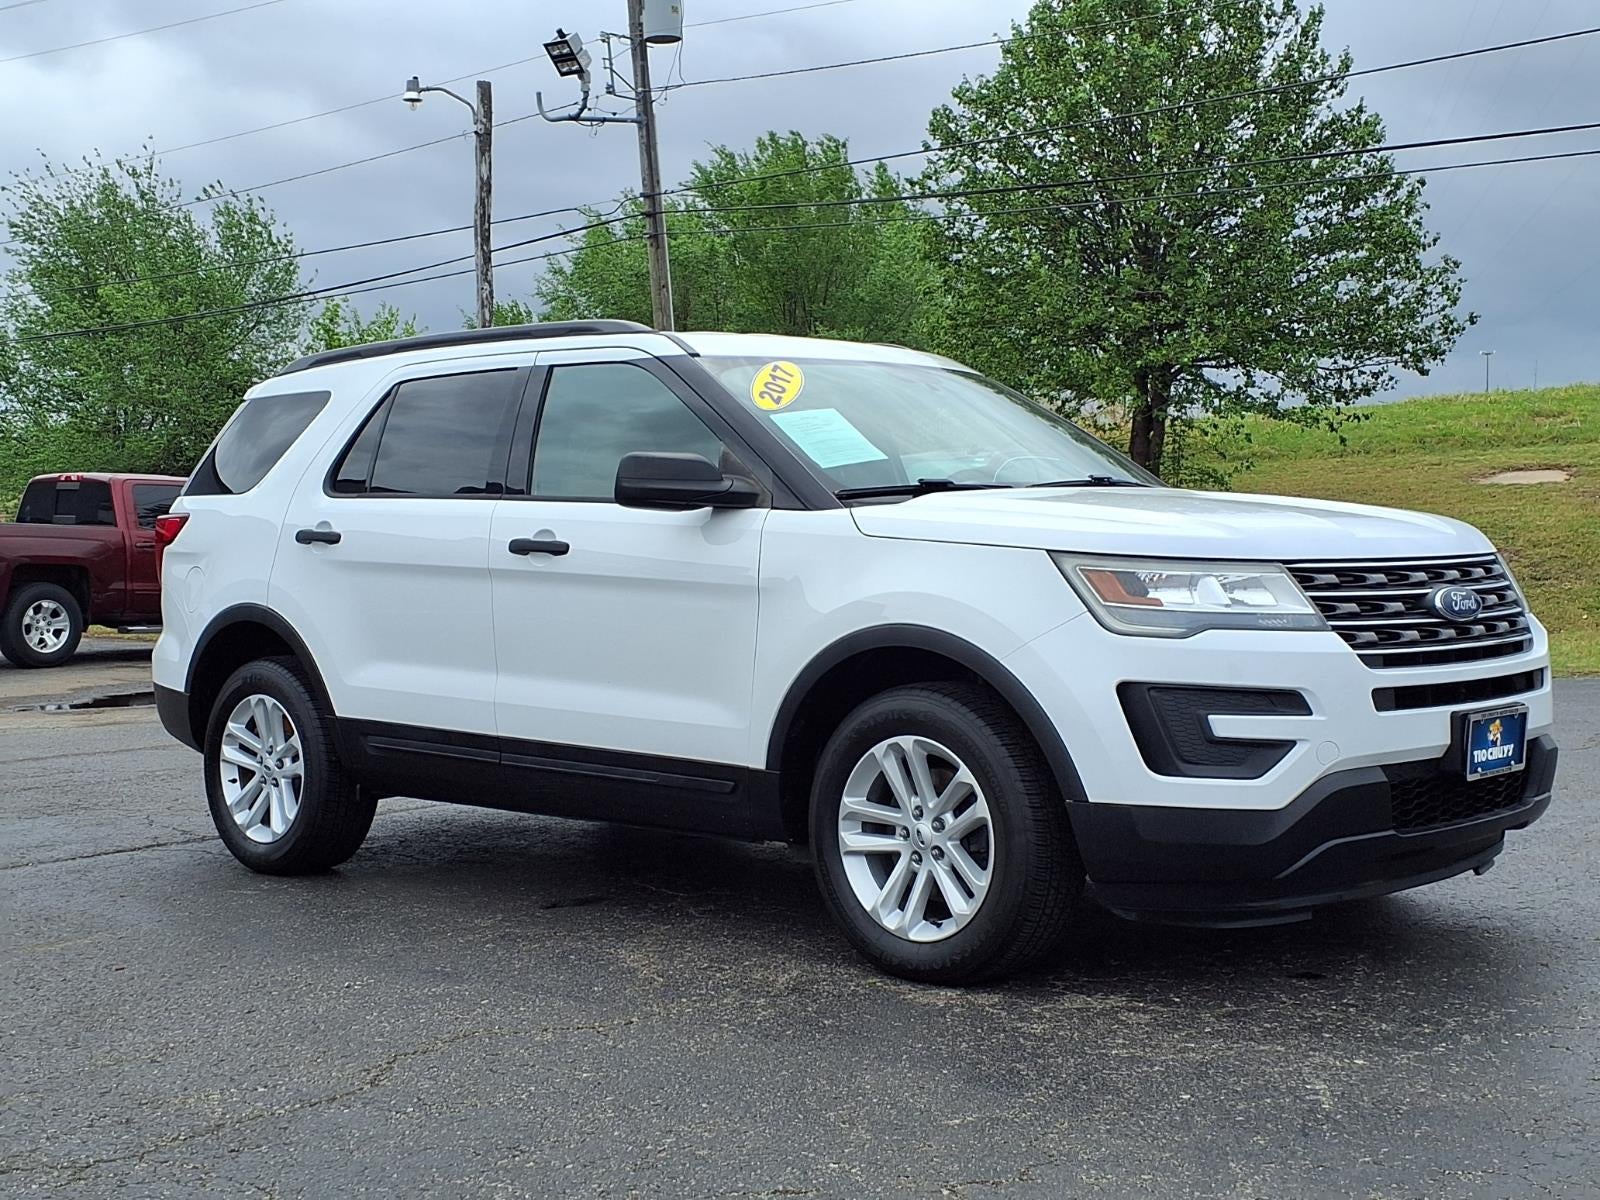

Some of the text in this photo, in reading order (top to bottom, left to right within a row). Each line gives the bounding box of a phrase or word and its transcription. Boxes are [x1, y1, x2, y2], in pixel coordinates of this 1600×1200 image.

[758, 364, 795, 406] 2017
[1450, 591, 1477, 611] Ford
[1473, 749, 1487, 764] TIO
